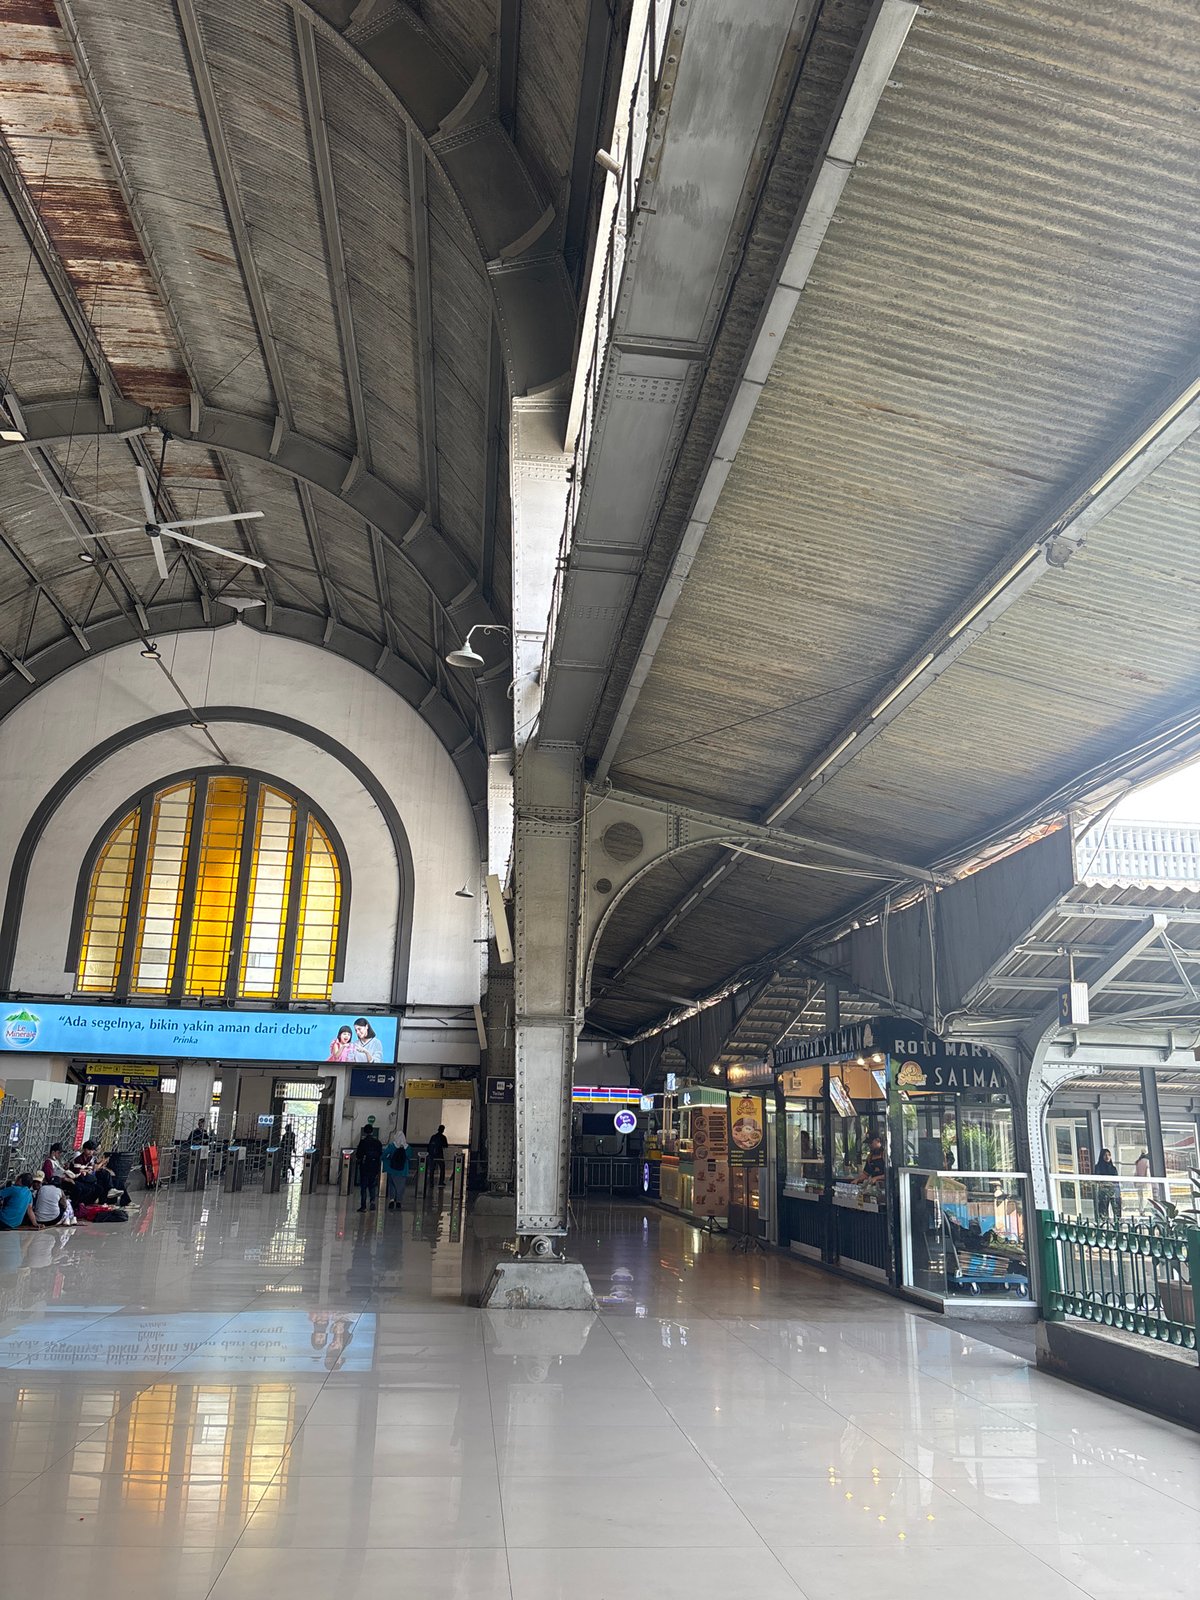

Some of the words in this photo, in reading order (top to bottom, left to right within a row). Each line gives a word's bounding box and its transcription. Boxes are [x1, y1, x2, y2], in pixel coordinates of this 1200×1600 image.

[1062, 993, 1069, 1017] 3
[17, 1024, 26, 1032] Le
[58, 1015, 87, 1027] “Ada
[91, 1017, 145, 1032] segelnya,
[149, 1018, 179, 1031] bikin
[183, 1020, 214, 1034] yakin
[218, 1024, 250, 1033] aman
[254, 1022, 277, 1034] dari
[281, 1023, 318, 1035] debu”
[173, 1035, 199, 1045] Prinka
[823, 1025, 862, 1056] SALMAN
[894, 1039, 937, 1057] ROTI
[935, 1067, 1007, 1088] SALMA
